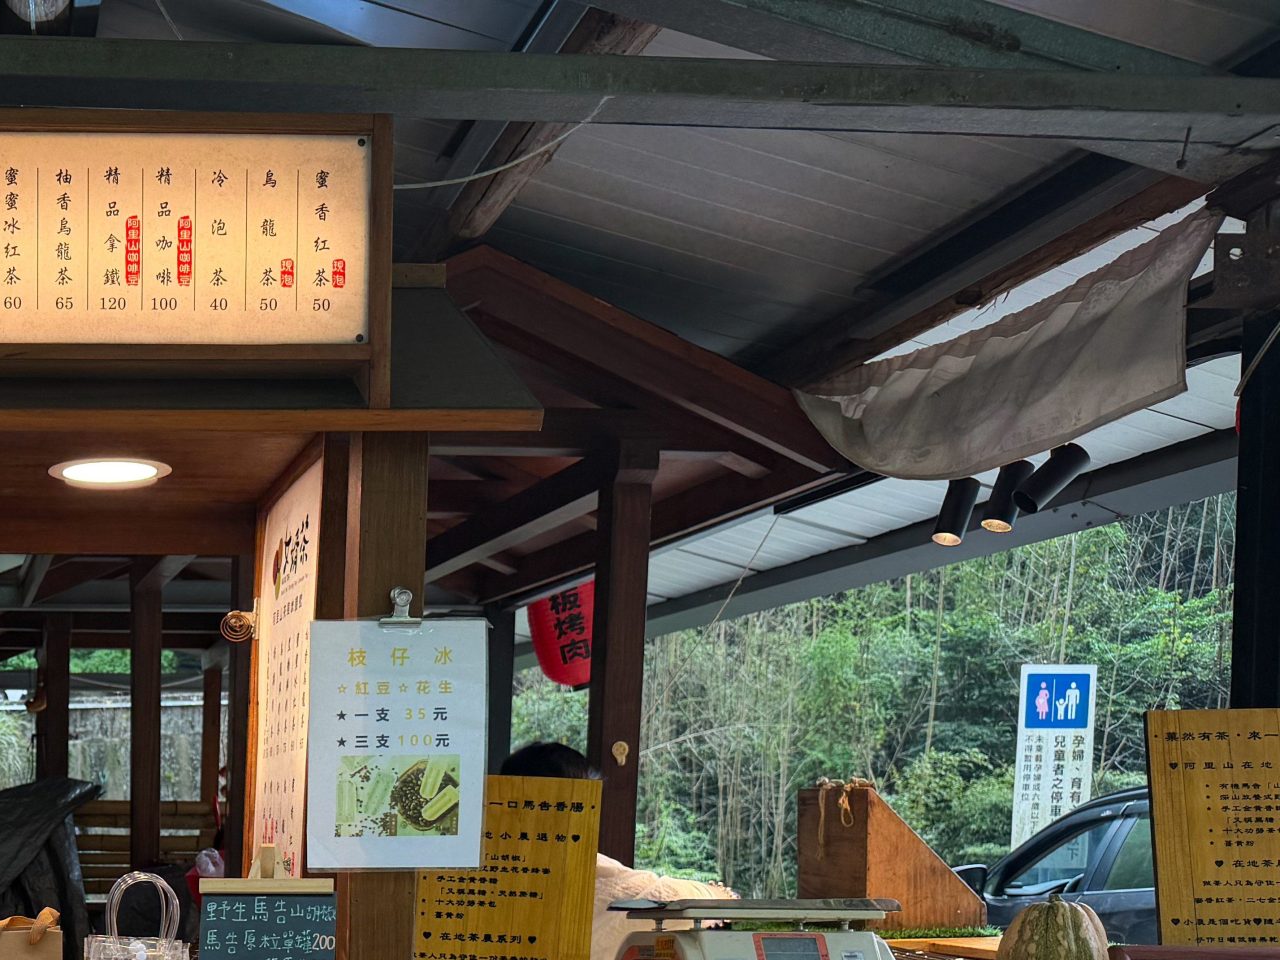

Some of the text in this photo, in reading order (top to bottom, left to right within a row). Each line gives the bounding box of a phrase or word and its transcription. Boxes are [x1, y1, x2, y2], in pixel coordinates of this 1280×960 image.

[103, 167, 122, 288] 精品拿鐵
[155, 168, 173, 286] 精品咖啡
[211, 170, 229, 288] 冷泡茶
[260, 170, 278, 288] 烏龍茶
[3, 297, 22, 310] 60
[54, 297, 74, 310] 65
[99, 298, 126, 312] 120
[151, 298, 178, 312] 100
[209, 298, 228, 312] 40
[259, 298, 278, 312] 50
[312, 298, 331, 312] 50
[347, 647, 453, 668] 枝仔冰
[1049, 735, 1066, 824] 兒童者之停車
[1070, 735, 1086, 810] 孕婦、育有
